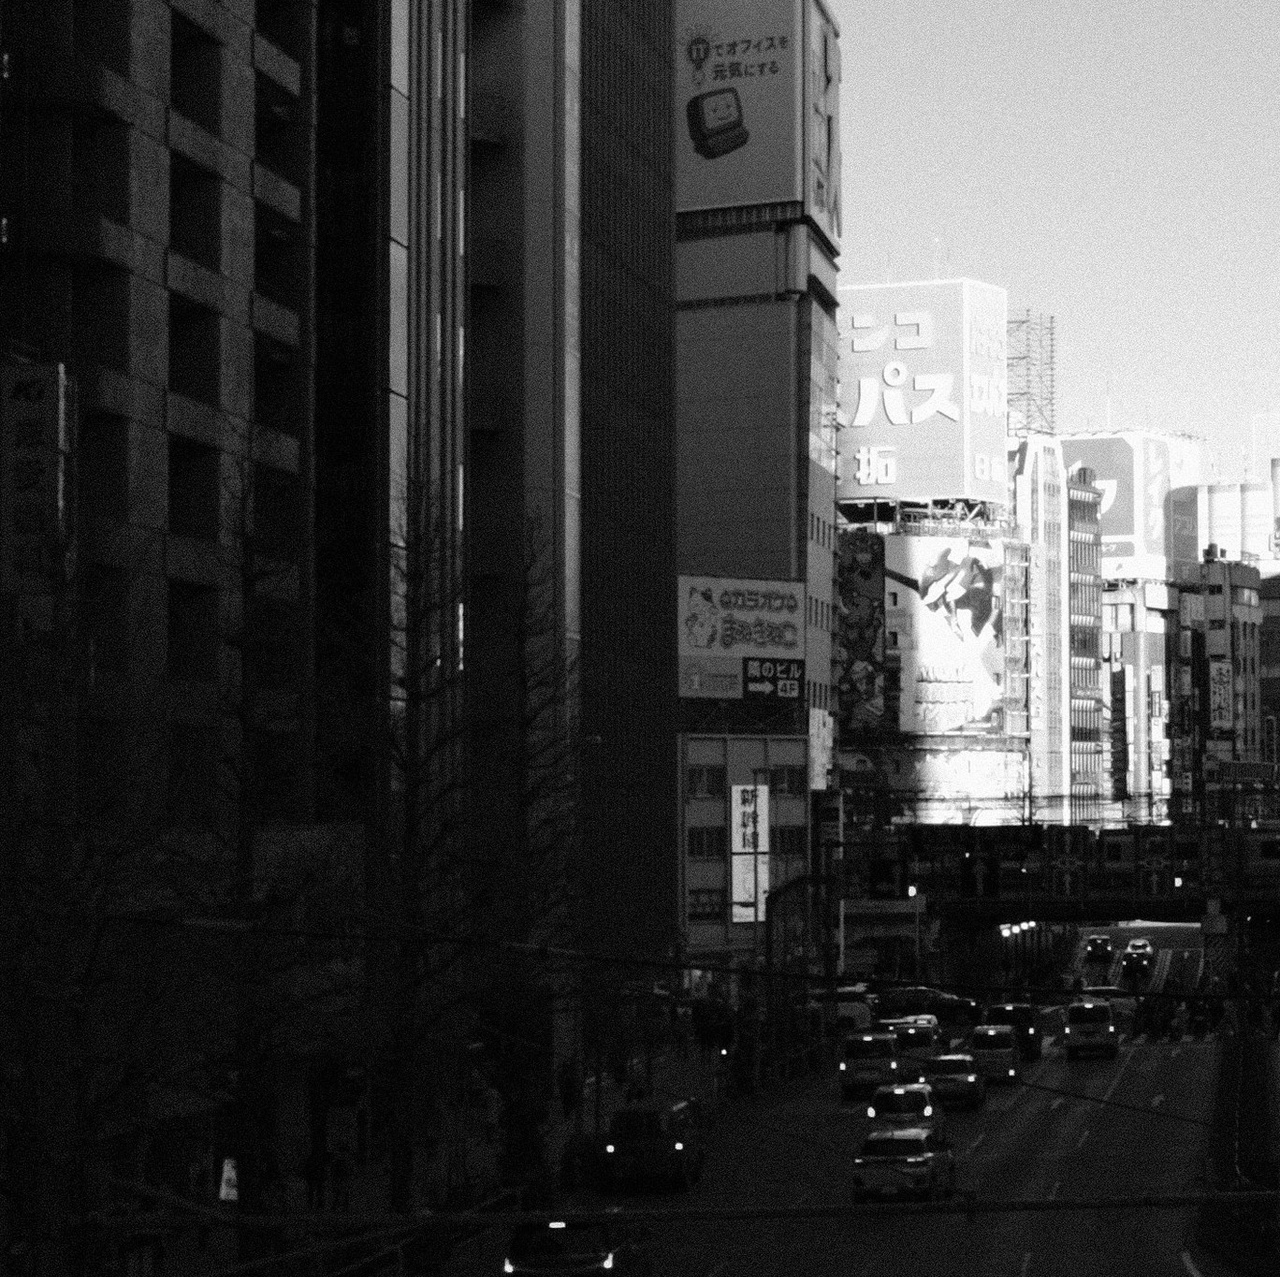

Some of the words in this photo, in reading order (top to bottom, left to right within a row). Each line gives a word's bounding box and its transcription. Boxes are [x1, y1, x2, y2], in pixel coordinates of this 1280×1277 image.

[713, 61, 780, 81] 元気にする
[840, 312, 934, 353] ンコ
[838, 360, 960, 428] パス
[747, 660, 802, 678] 隣のビル
[779, 682, 798, 694] 4F
